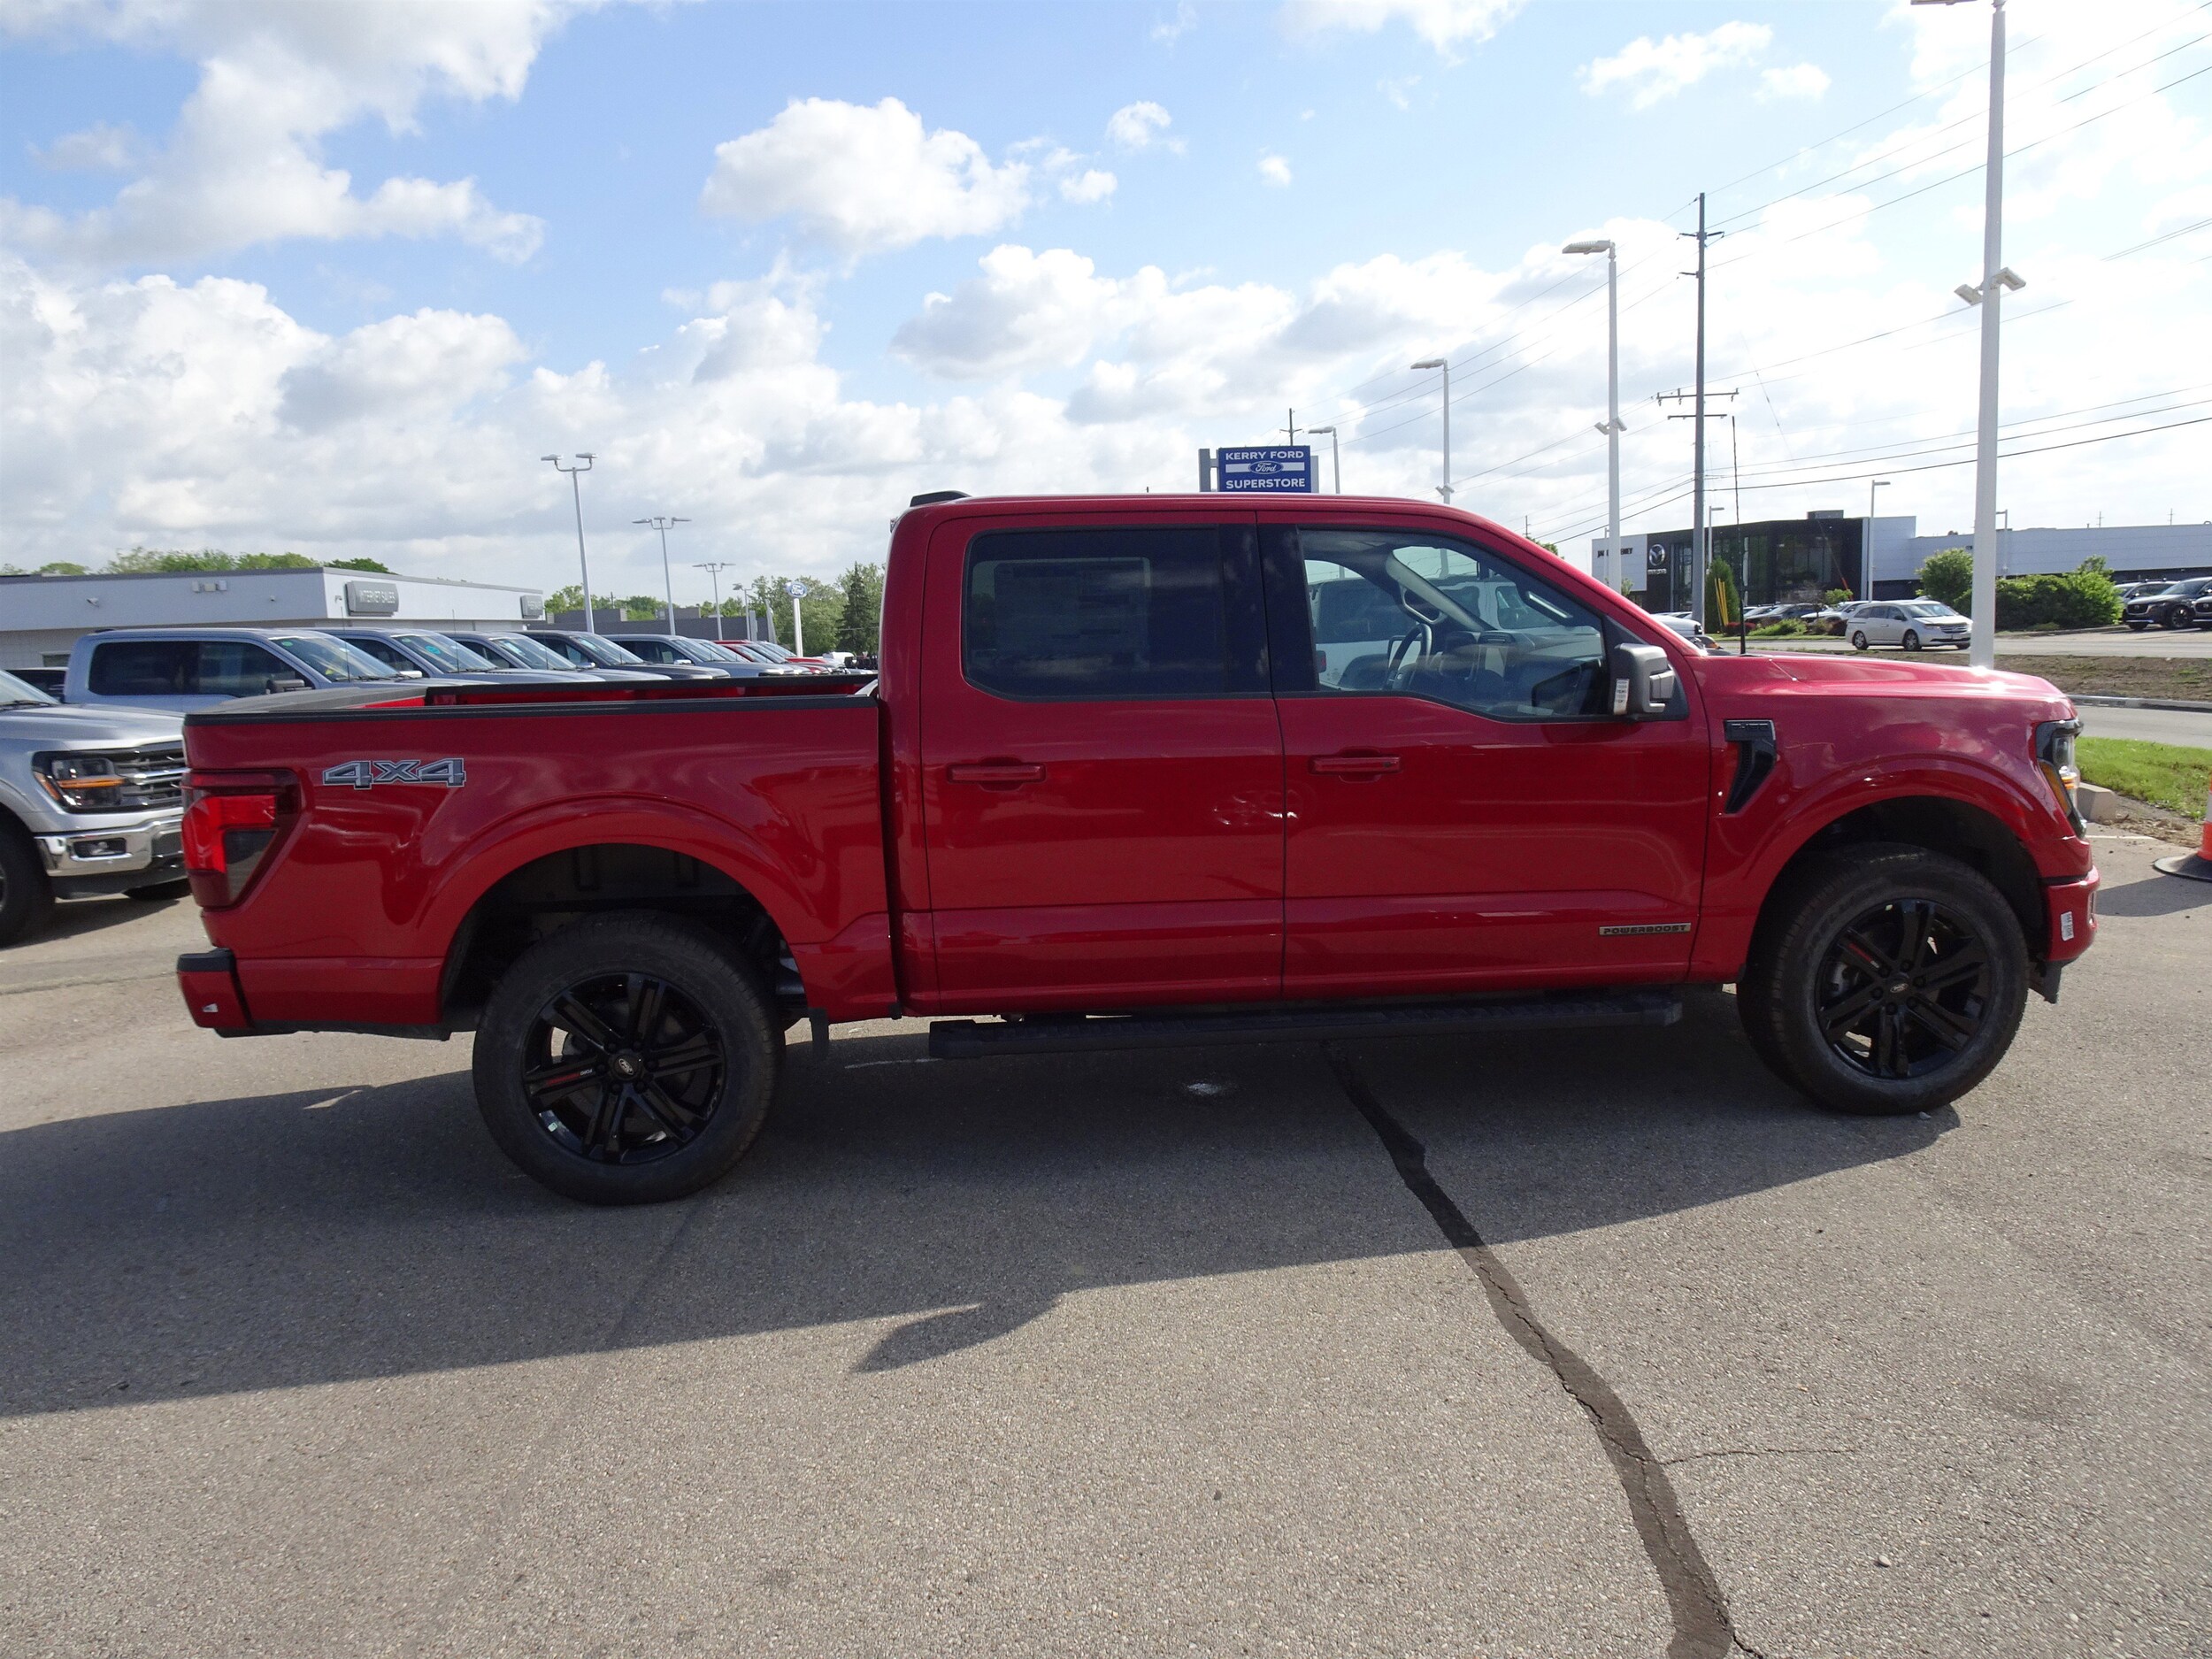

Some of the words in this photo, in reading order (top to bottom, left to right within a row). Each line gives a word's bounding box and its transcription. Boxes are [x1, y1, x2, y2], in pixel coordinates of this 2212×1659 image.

[1225, 451, 1267, 461] KERRY
[1270, 450, 1305, 459] FORD
[1255, 462, 1277, 472] Ford
[1225, 478, 1306, 489] SUPERSTORE
[1602, 925, 1687, 934] POWERBOOST
